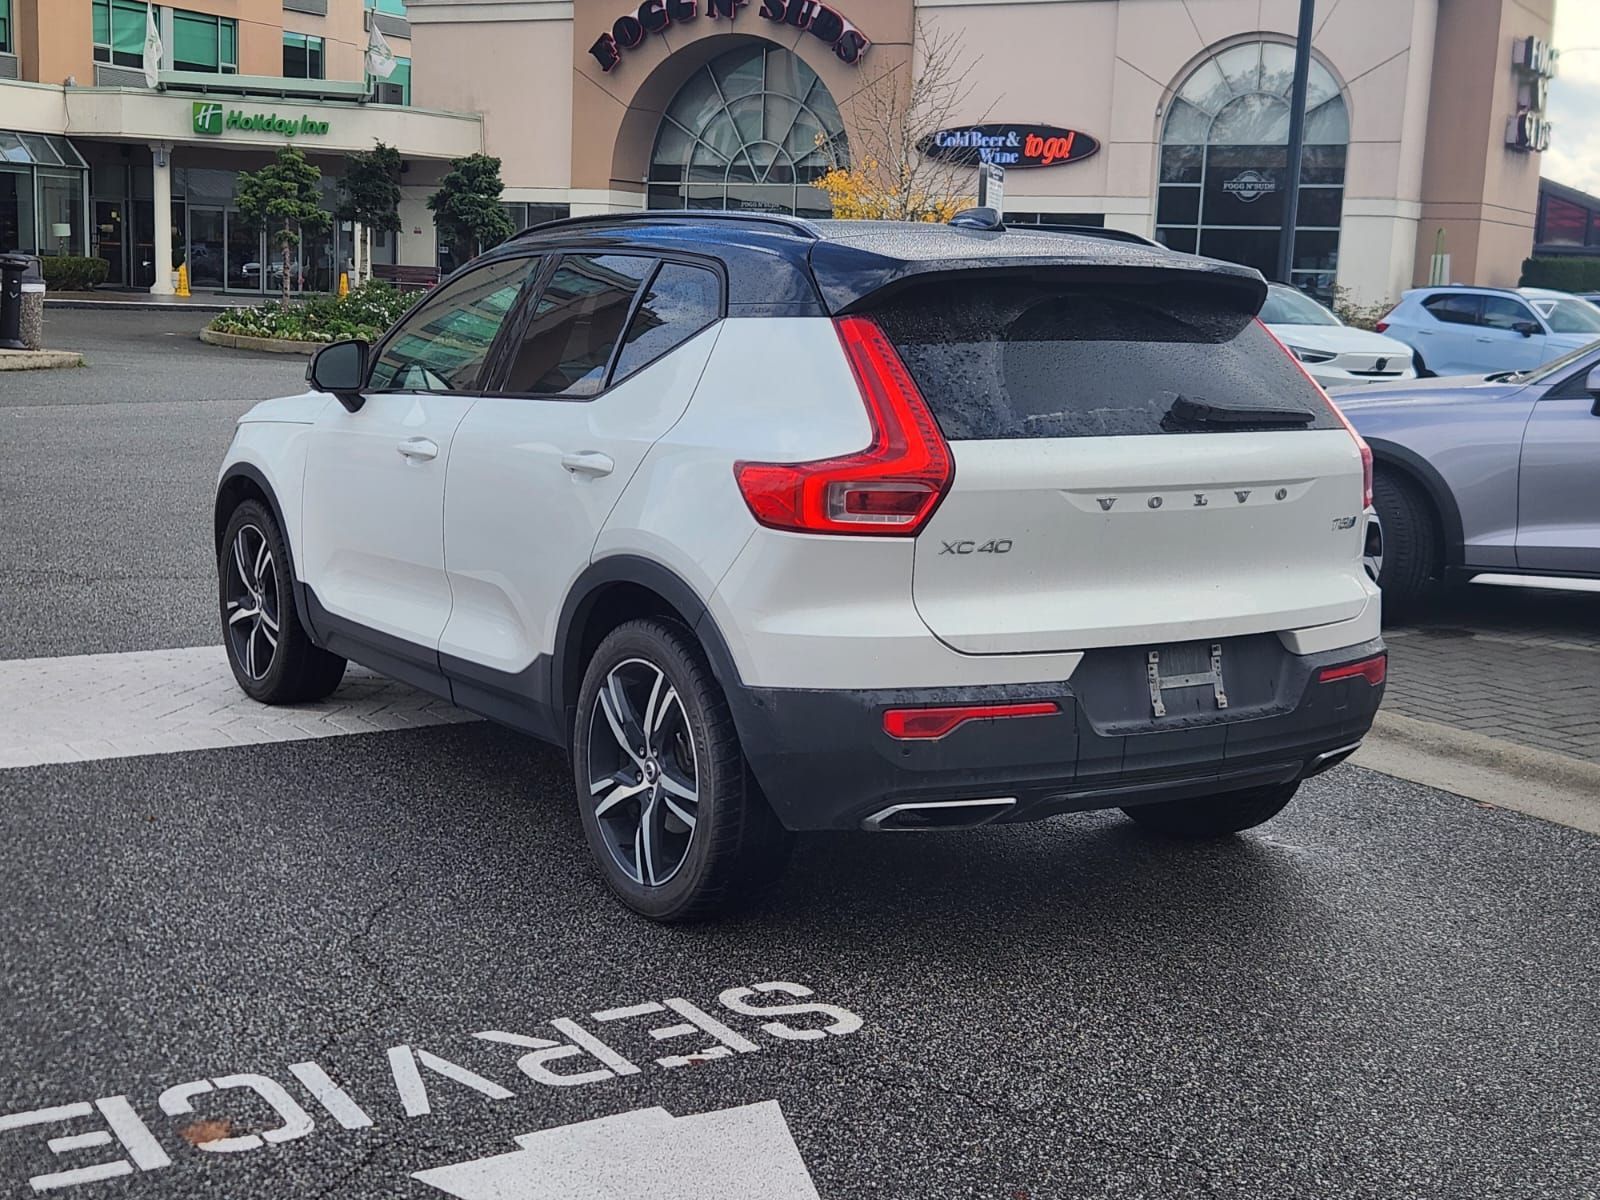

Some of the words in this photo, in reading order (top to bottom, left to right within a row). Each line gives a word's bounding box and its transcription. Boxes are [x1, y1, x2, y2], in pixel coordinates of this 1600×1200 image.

[589, 0, 697, 73] FOGG
[759, 0, 872, 64] SUDS
[227, 110, 298, 137] Holiday
[300, 114, 330, 134] Inn
[935, 131, 970, 148] Cold
[970, 131, 1005, 148] Beer
[1005, 131, 1022, 148] &
[1024, 133, 1043, 158] to
[1041, 130, 1075, 166] go!
[979, 147, 1019, 164] Wine
[1096, 487, 1288, 512] VOLVO
[0, 981, 864, 1193] SERVICE
